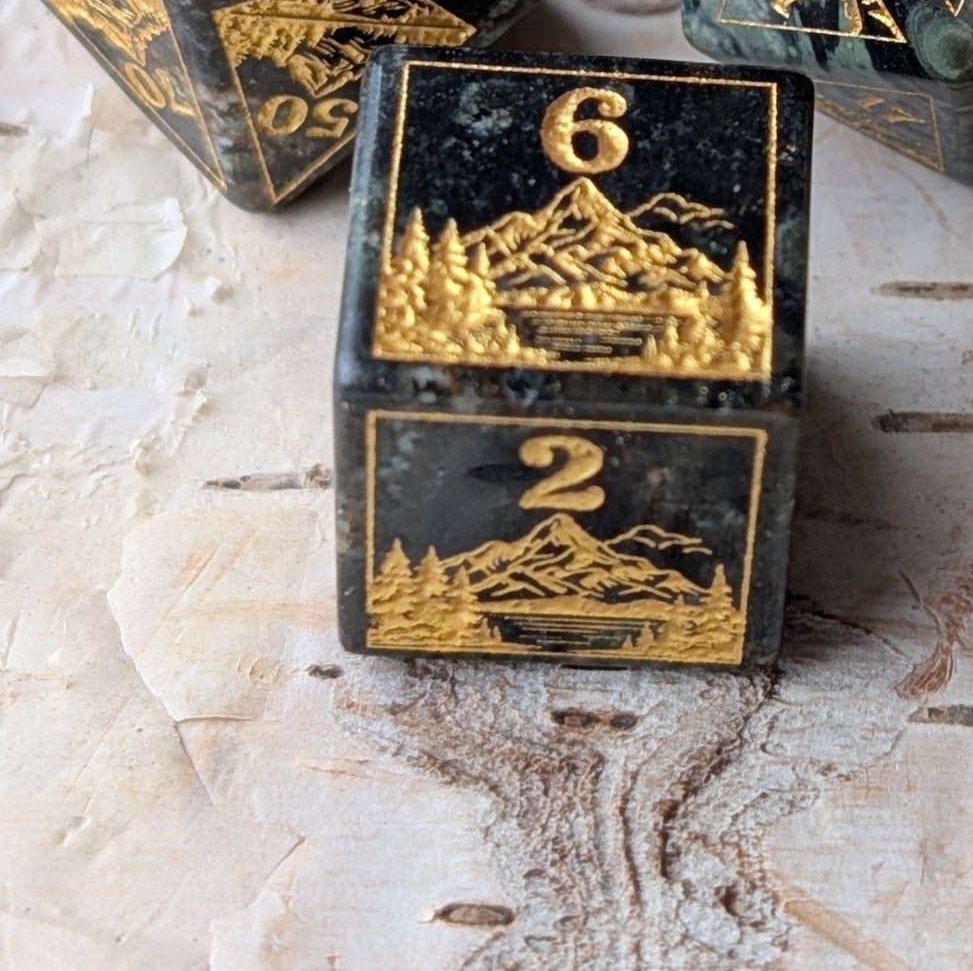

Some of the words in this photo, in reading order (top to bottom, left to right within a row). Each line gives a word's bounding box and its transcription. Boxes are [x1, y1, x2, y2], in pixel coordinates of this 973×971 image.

[257, 94, 358, 137] 50
[541, 86, 630, 174] 6
[519, 434, 605, 512] 2
